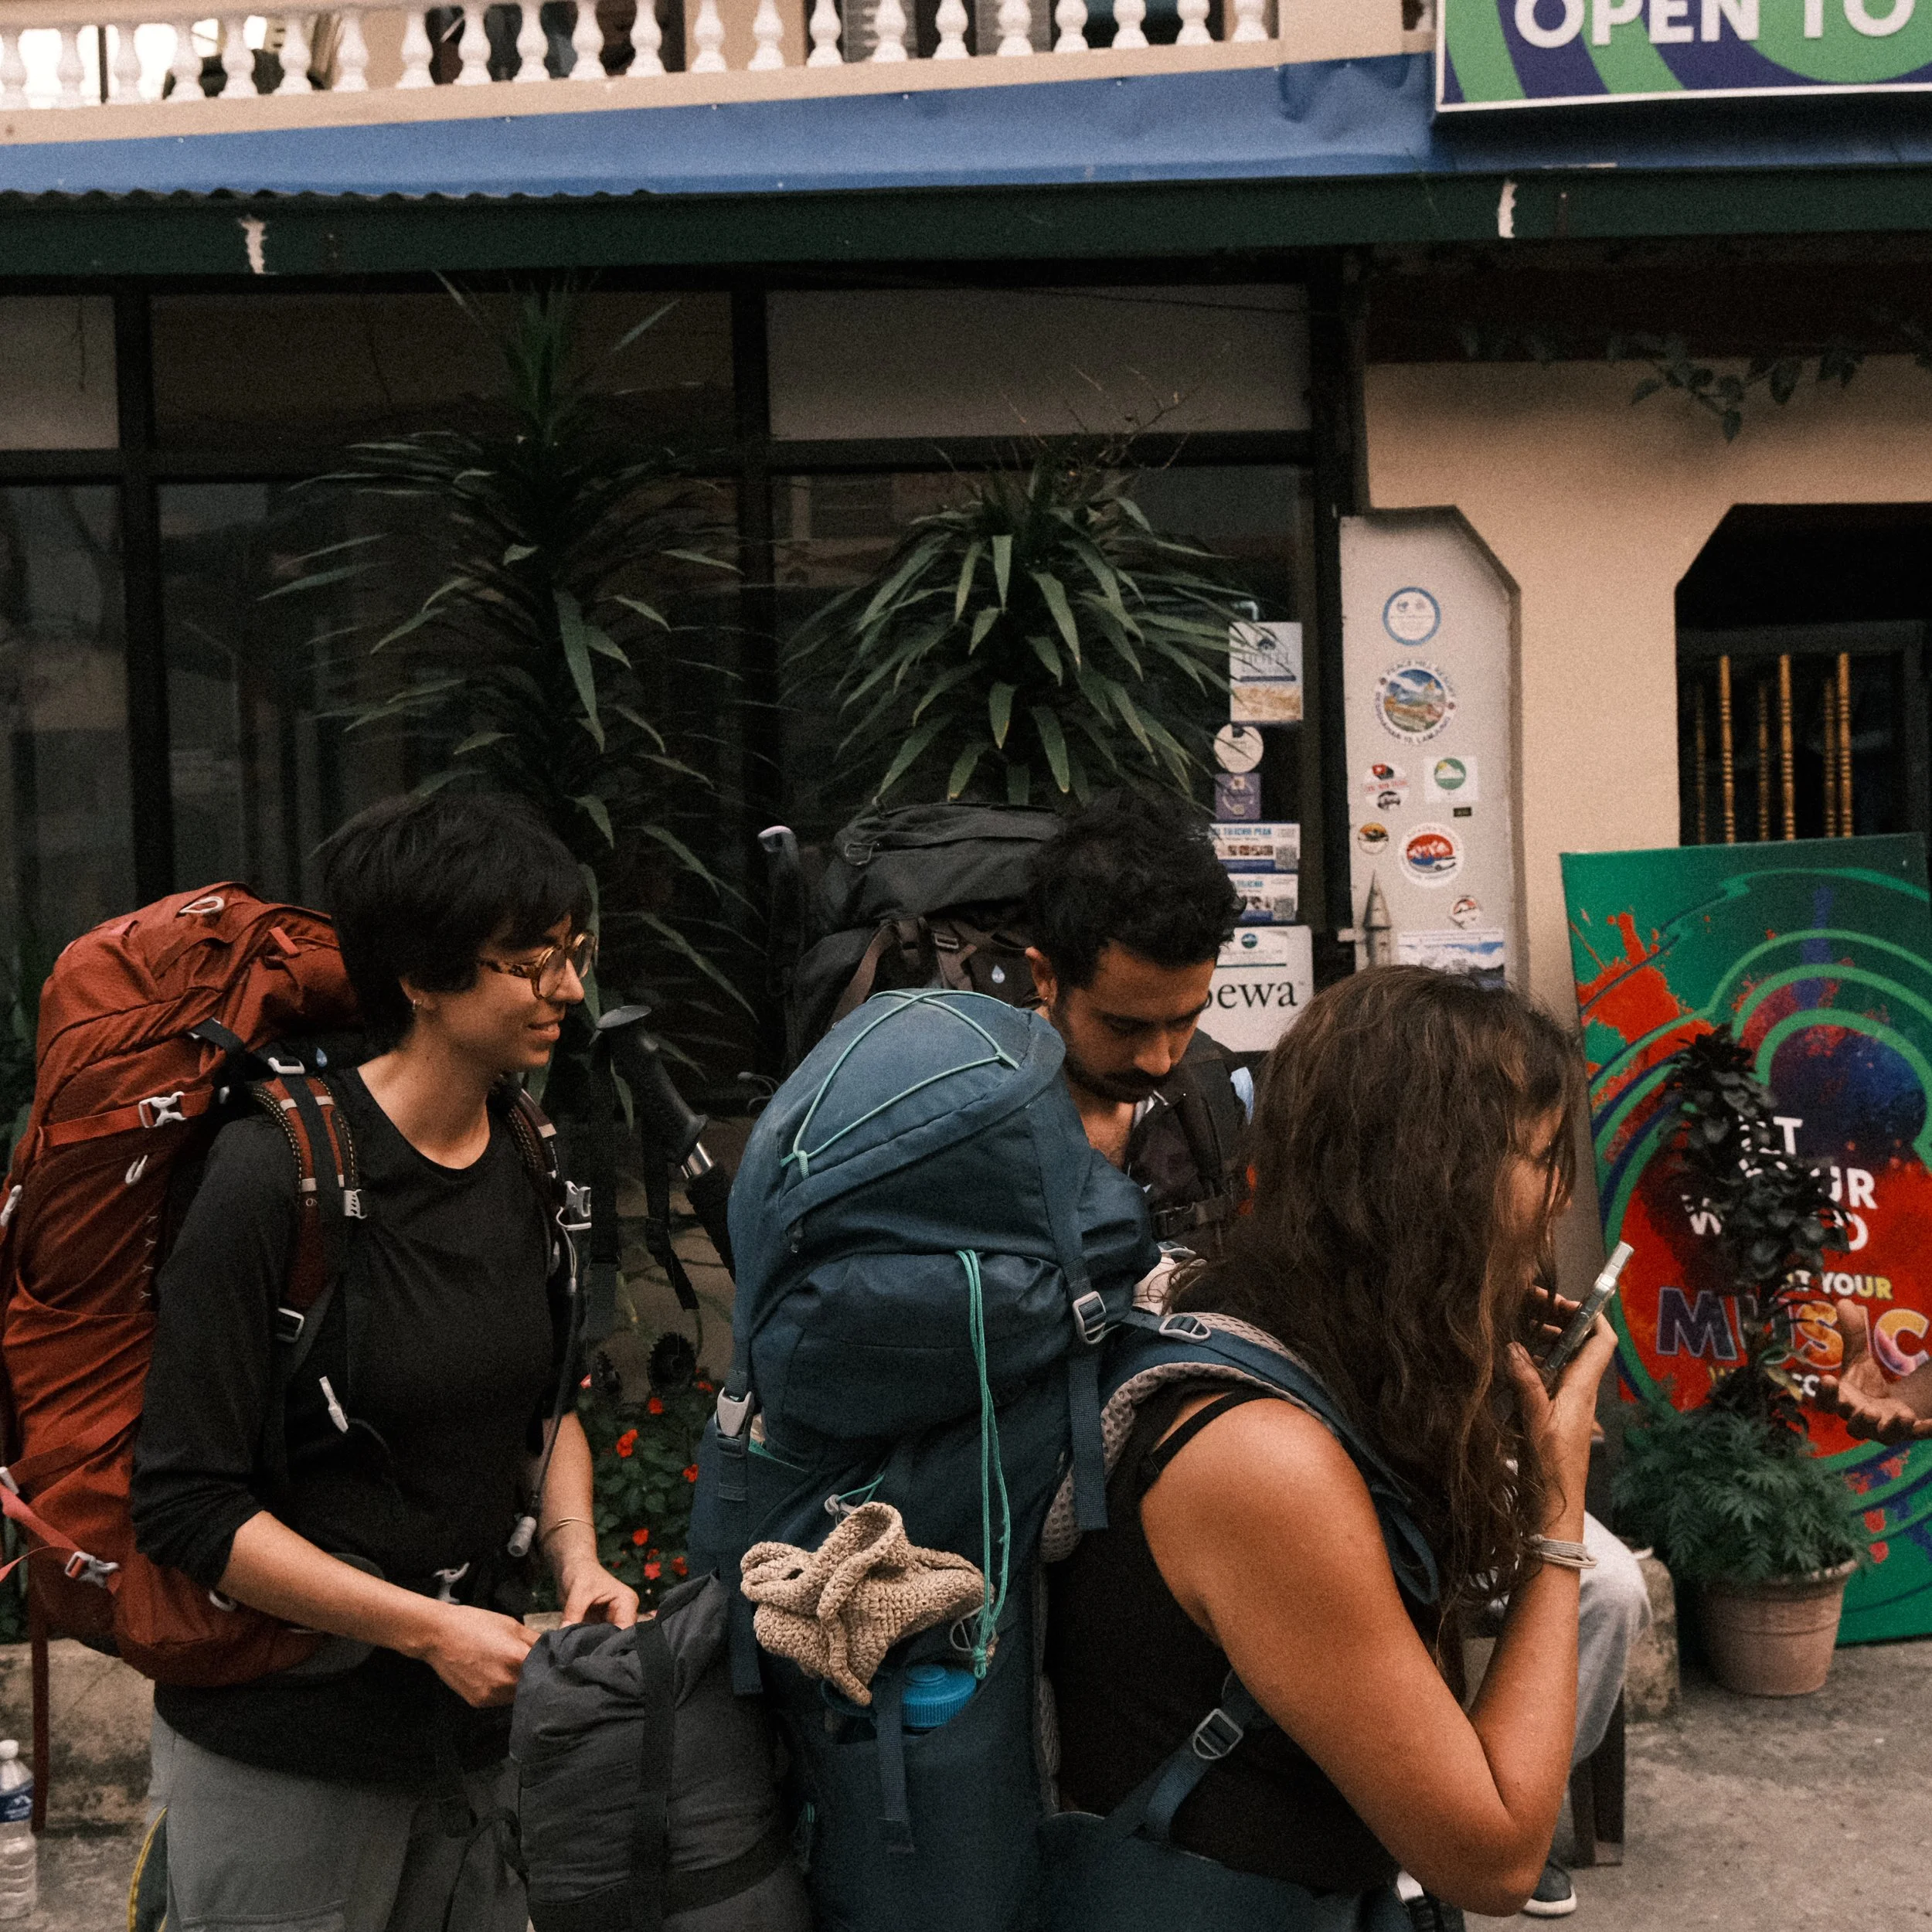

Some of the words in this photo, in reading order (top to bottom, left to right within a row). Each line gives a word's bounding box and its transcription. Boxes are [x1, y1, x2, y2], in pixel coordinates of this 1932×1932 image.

[1515, 0, 1760, 49] OPEN
[1821, 1270, 1893, 1301] YOUR
[1655, 1285, 1930, 1377] MSC
